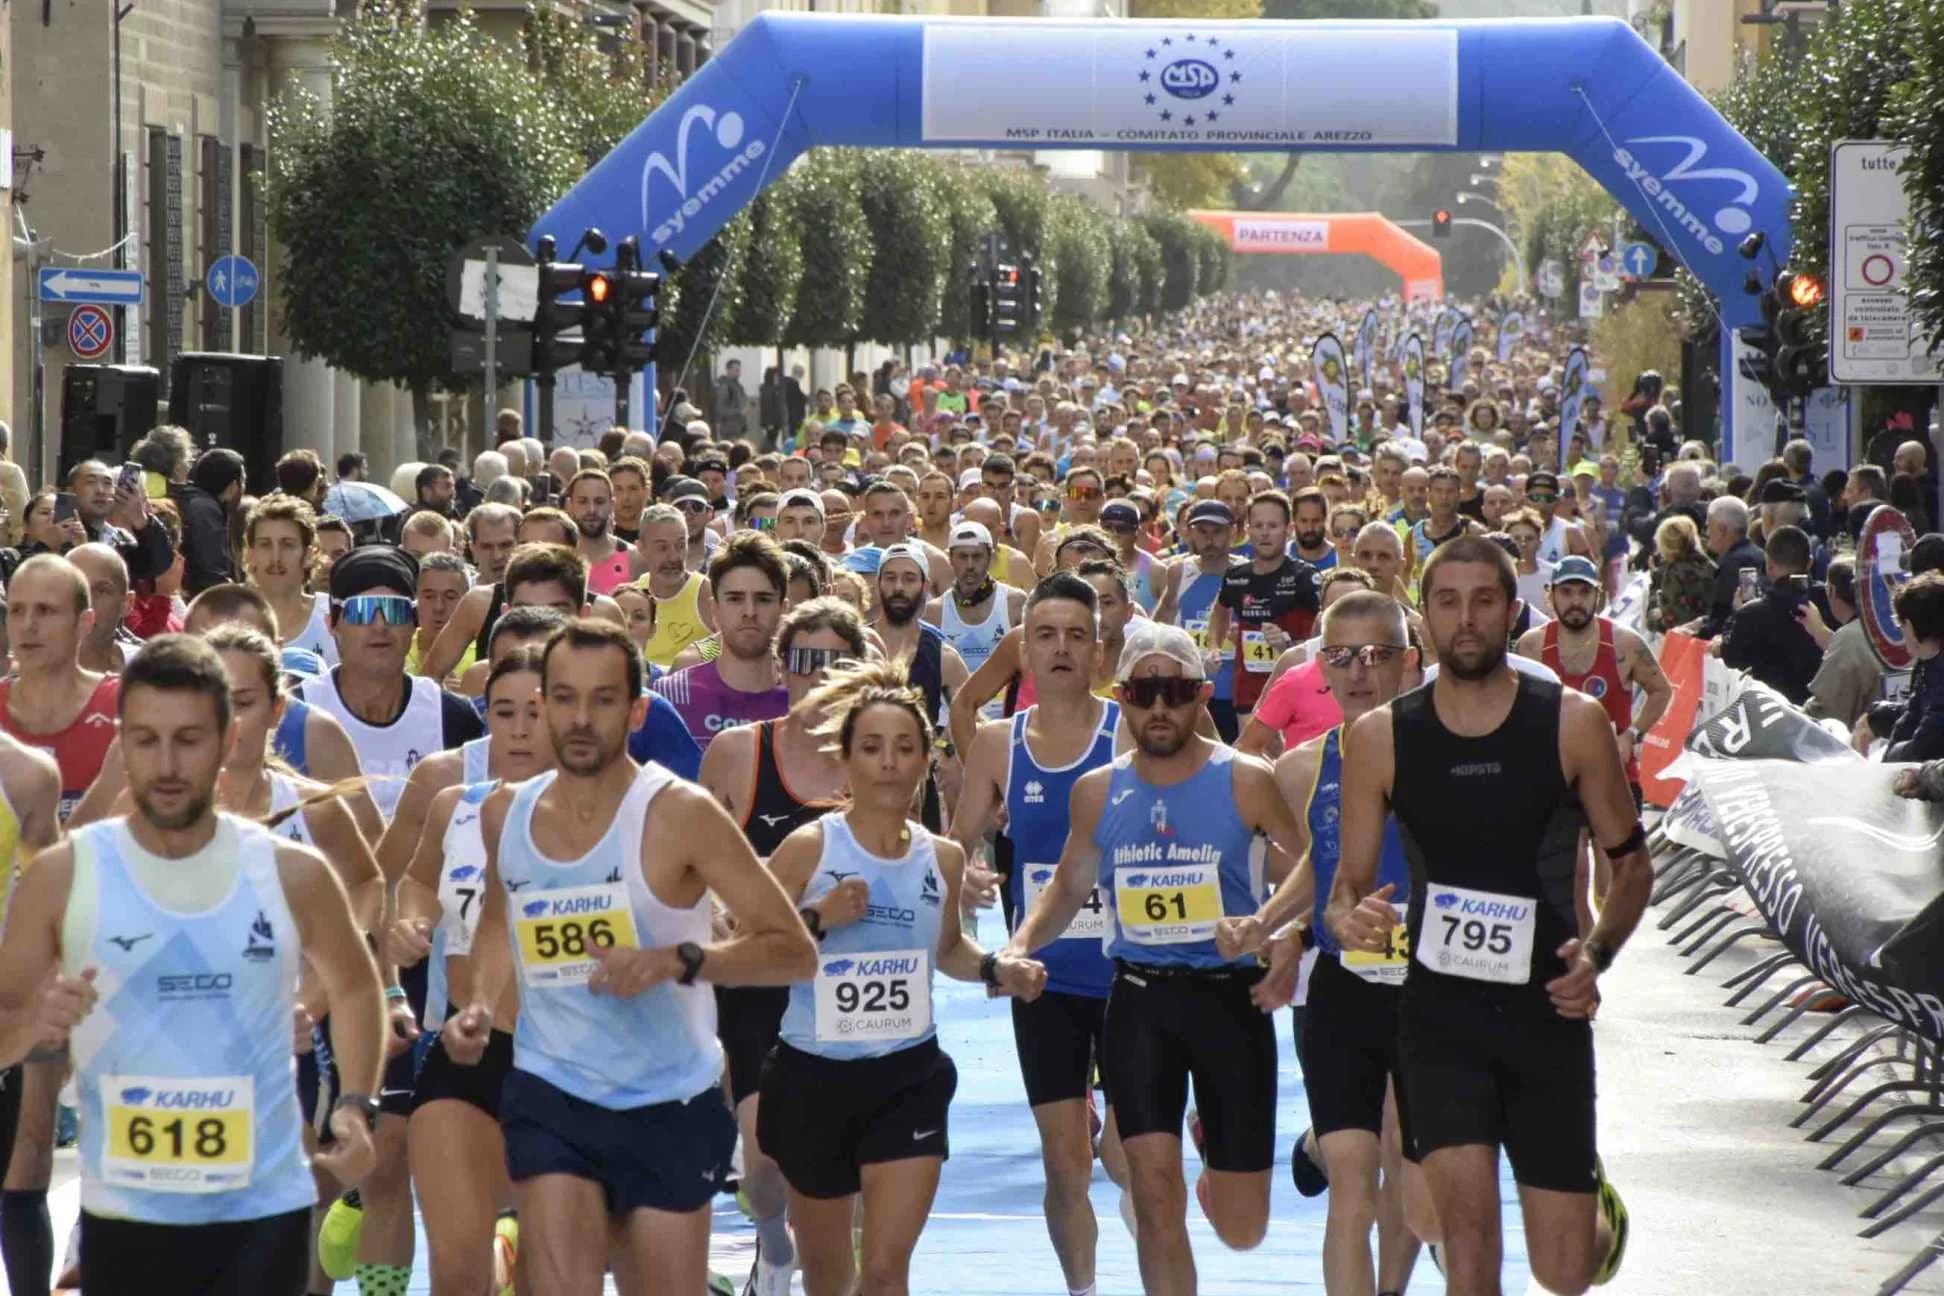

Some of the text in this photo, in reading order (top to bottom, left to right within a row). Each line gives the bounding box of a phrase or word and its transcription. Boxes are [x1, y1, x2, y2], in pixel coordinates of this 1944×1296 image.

[1006, 127, 1373, 142] MSP ITALIA COMITATO PROVINCIALE AREZZO
[1861, 156, 1896, 170] tutte
[651, 139, 766, 245] syemme
[1614, 148, 1723, 255] syemme
[1239, 229, 1323, 243] PARTENZA
[1253, 645, 1274, 660] 41
[1151, 873, 1203, 887] KARHU
[552, 894, 612, 915] KARHU
[1144, 892, 1187, 921] 61
[1461, 899, 1528, 921] KARHU
[534, 918, 616, 959] 586
[1442, 915, 1513, 955] 795
[857, 958, 918, 977] KARHU
[1453, 955, 1510, 975] CAURUM
[158, 973, 232, 992] SECO
[836, 979, 910, 1014] 925
[855, 1017, 912, 1031] CAURUM
[154, 1088, 234, 1110] KARHU
[128, 1115, 226, 1158] 618
